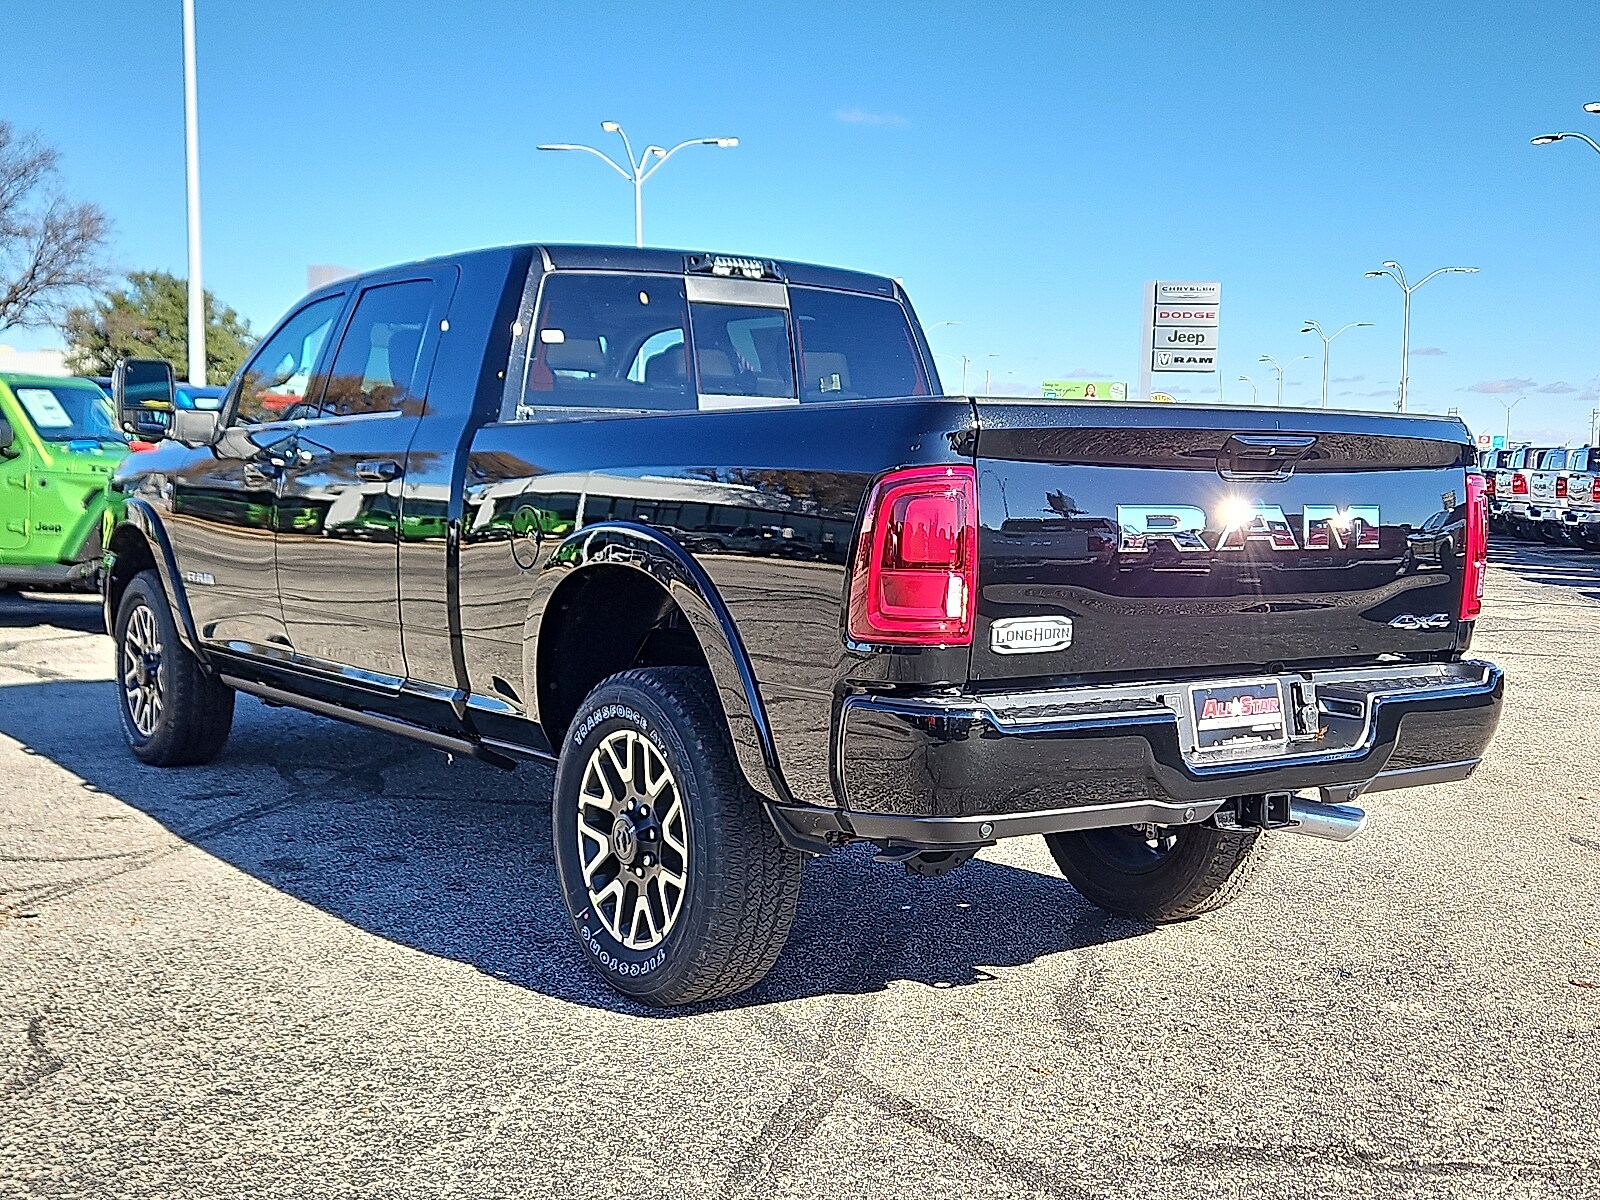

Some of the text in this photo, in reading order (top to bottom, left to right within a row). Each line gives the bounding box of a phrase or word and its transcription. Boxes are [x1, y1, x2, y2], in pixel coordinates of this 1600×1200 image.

[1159, 311, 1216, 319] DODGE
[1167, 329, 1206, 346] Jeep
[1173, 356, 1214, 364] RAM
[34, 521, 62, 533] Jeep
[1115, 503, 1381, 553] RAM
[573, 704, 648, 746] TRANSFORCE
